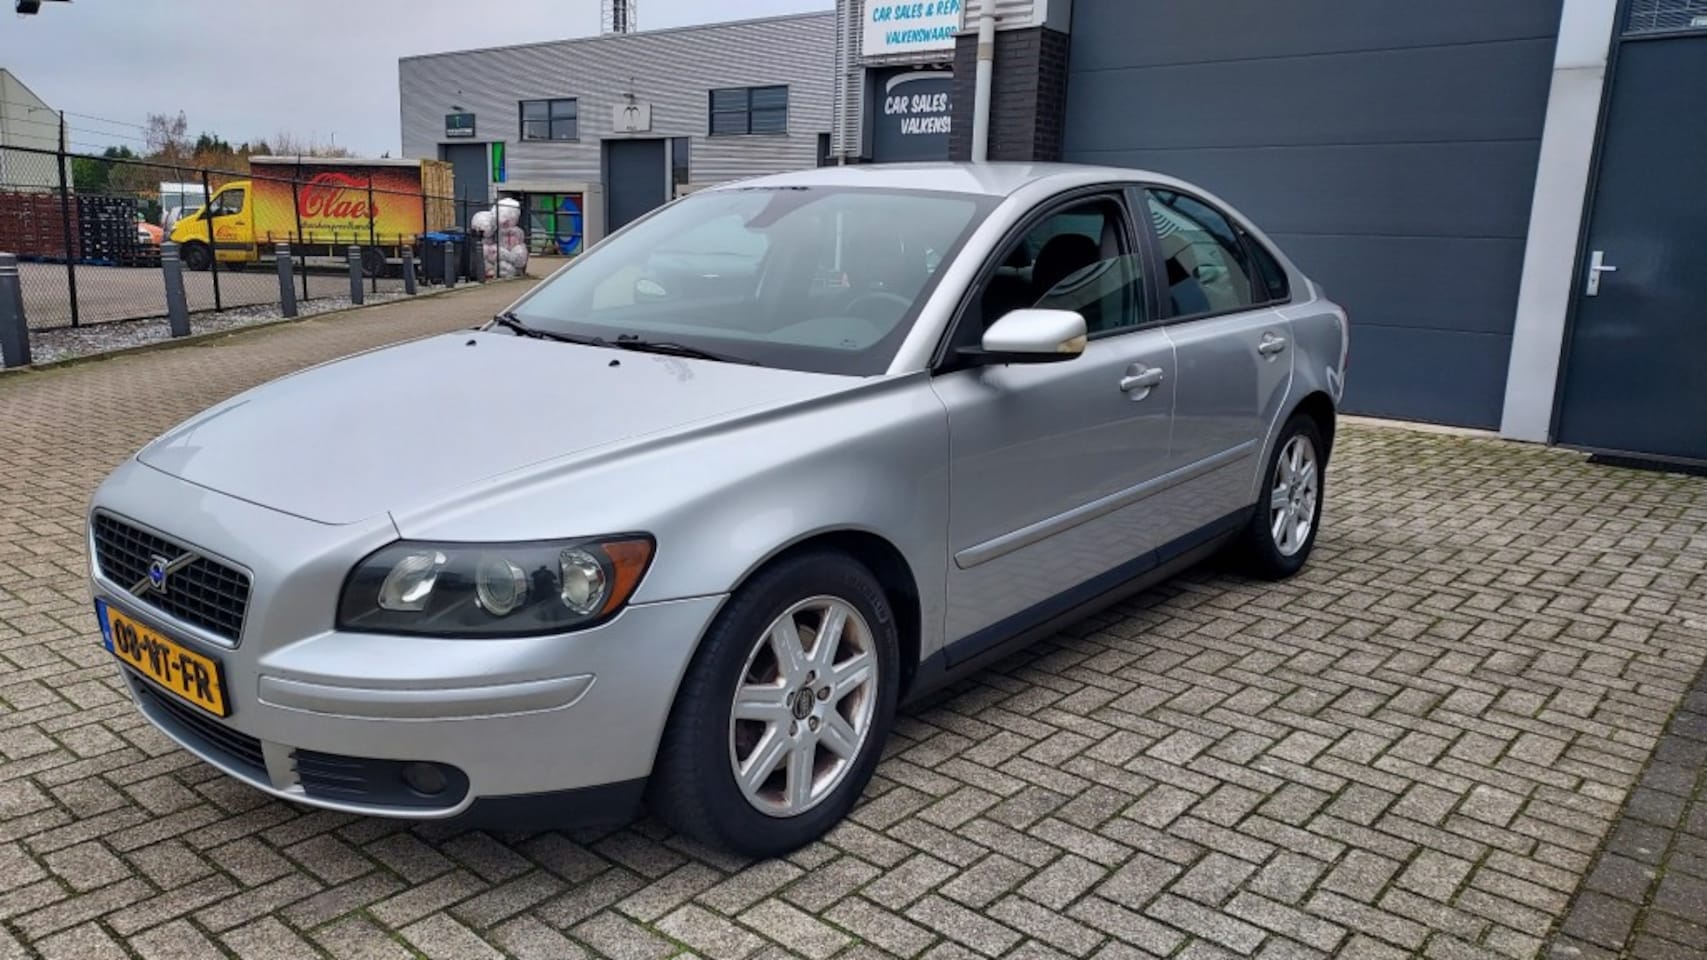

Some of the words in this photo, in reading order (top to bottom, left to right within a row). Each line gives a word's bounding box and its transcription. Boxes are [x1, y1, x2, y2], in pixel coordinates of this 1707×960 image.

[873, 6, 892, 22] CAR
[895, 3, 923, 20] SALES
[925, 3, 934, 16] &
[884, 95, 909, 115] CAR
[911, 92, 948, 113] SALES
[901, 116, 951, 134] VALKENS
[114, 619, 215, 703] 08-NT-FR
